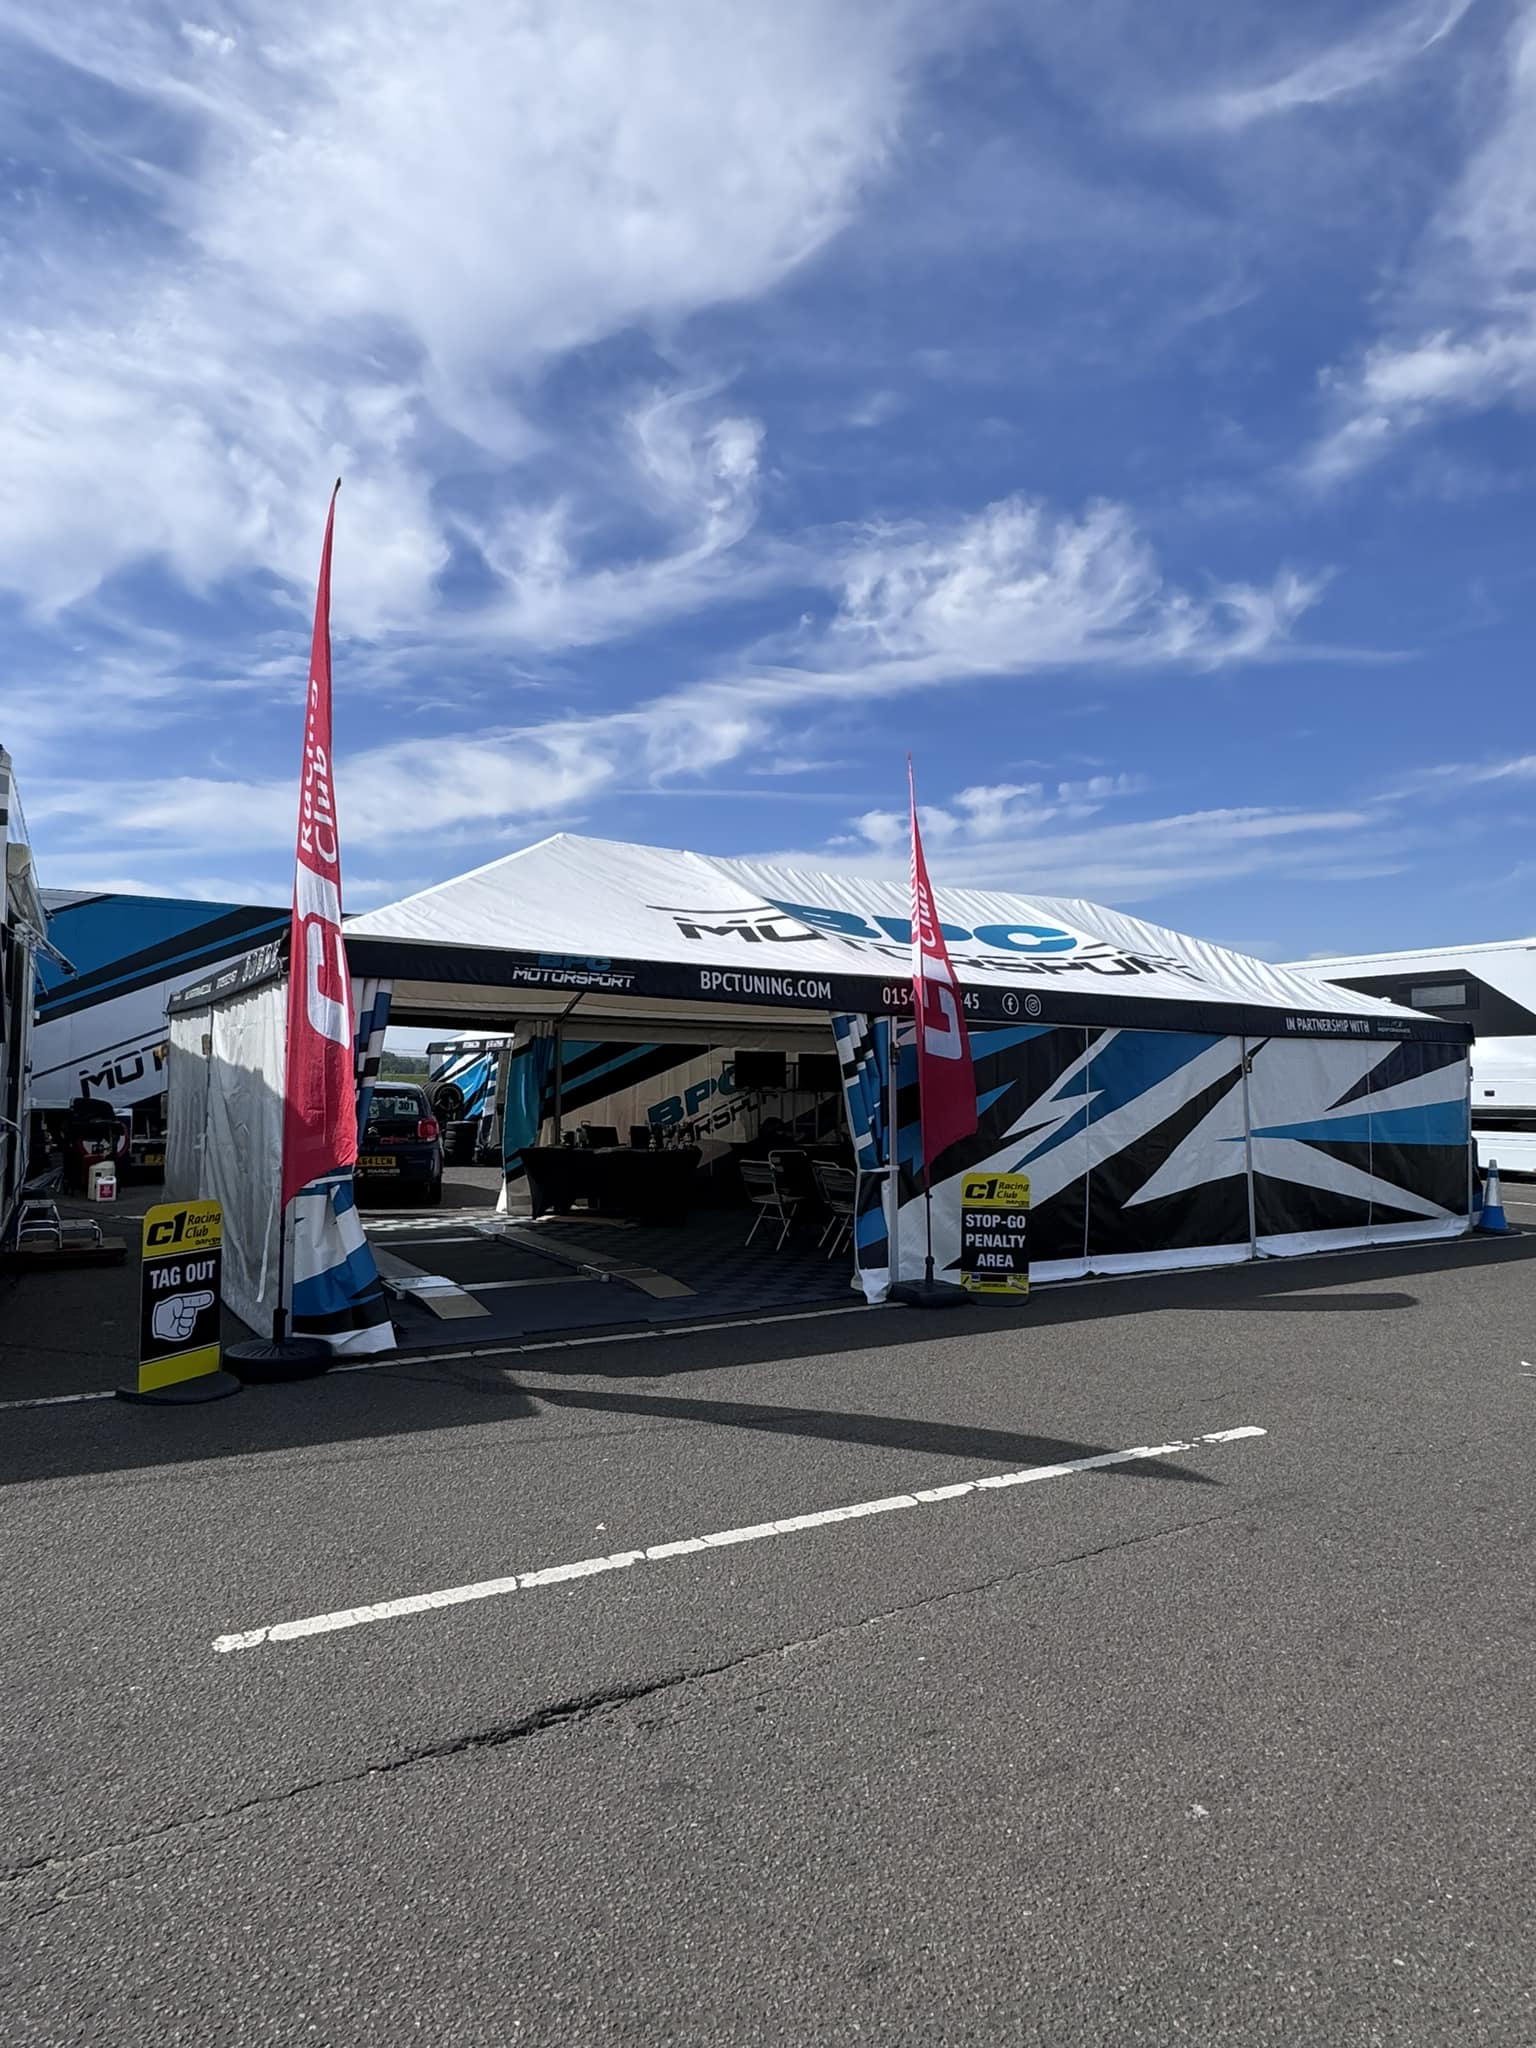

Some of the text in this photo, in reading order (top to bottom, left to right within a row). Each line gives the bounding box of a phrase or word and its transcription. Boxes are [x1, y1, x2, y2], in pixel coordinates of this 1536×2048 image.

[313, 745, 337, 864] Club
[512, 966, 636, 988] MOTORSPORT
[700, 970, 832, 1000] BPCTUNING.COM
[1285, 1017, 1297, 1031] IN
[1297, 1018, 1349, 1032] PARTNERSHIP
[1349, 1020, 1370, 1033] WITH
[999, 1181, 1029, 1191] Racing
[997, 1190, 1018, 1199] Club
[187, 1212, 221, 1226] Racing
[965, 1213, 1026, 1229] STOP-GO
[185, 1225, 209, 1239] Club
[965, 1233, 1026, 1249] PENALTY
[976, 1253, 1015, 1268] AREA
[150, 1259, 216, 1290] TAG OUT
